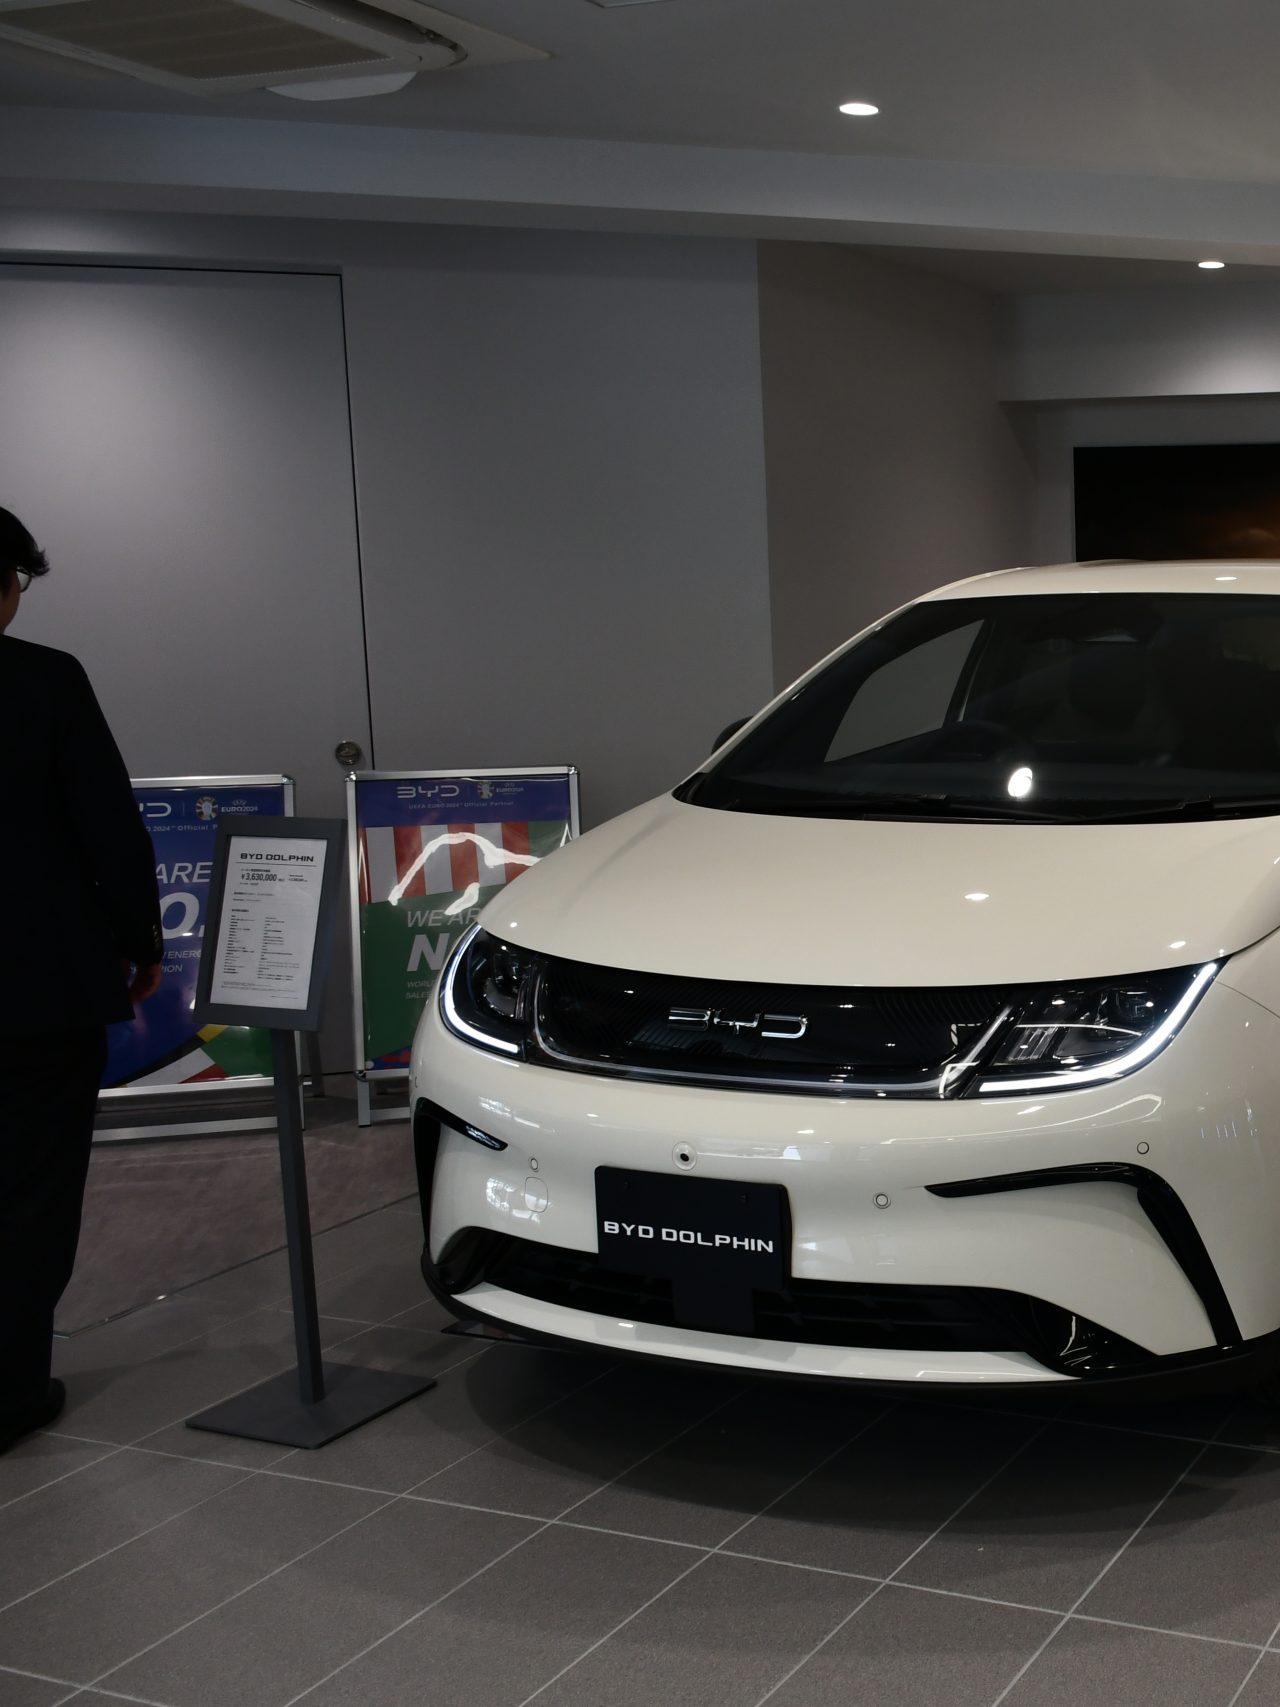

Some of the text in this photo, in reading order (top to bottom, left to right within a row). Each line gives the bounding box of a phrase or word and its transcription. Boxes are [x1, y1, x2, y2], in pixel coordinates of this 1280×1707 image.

[396, 784, 460, 799] BYD
[265, 854, 314, 862] DOLPHIN
[407, 907, 481, 928] WE AR
[668, 1006, 808, 1040] BYD
[603, 1220, 774, 1254] BYD DOLPHIN
